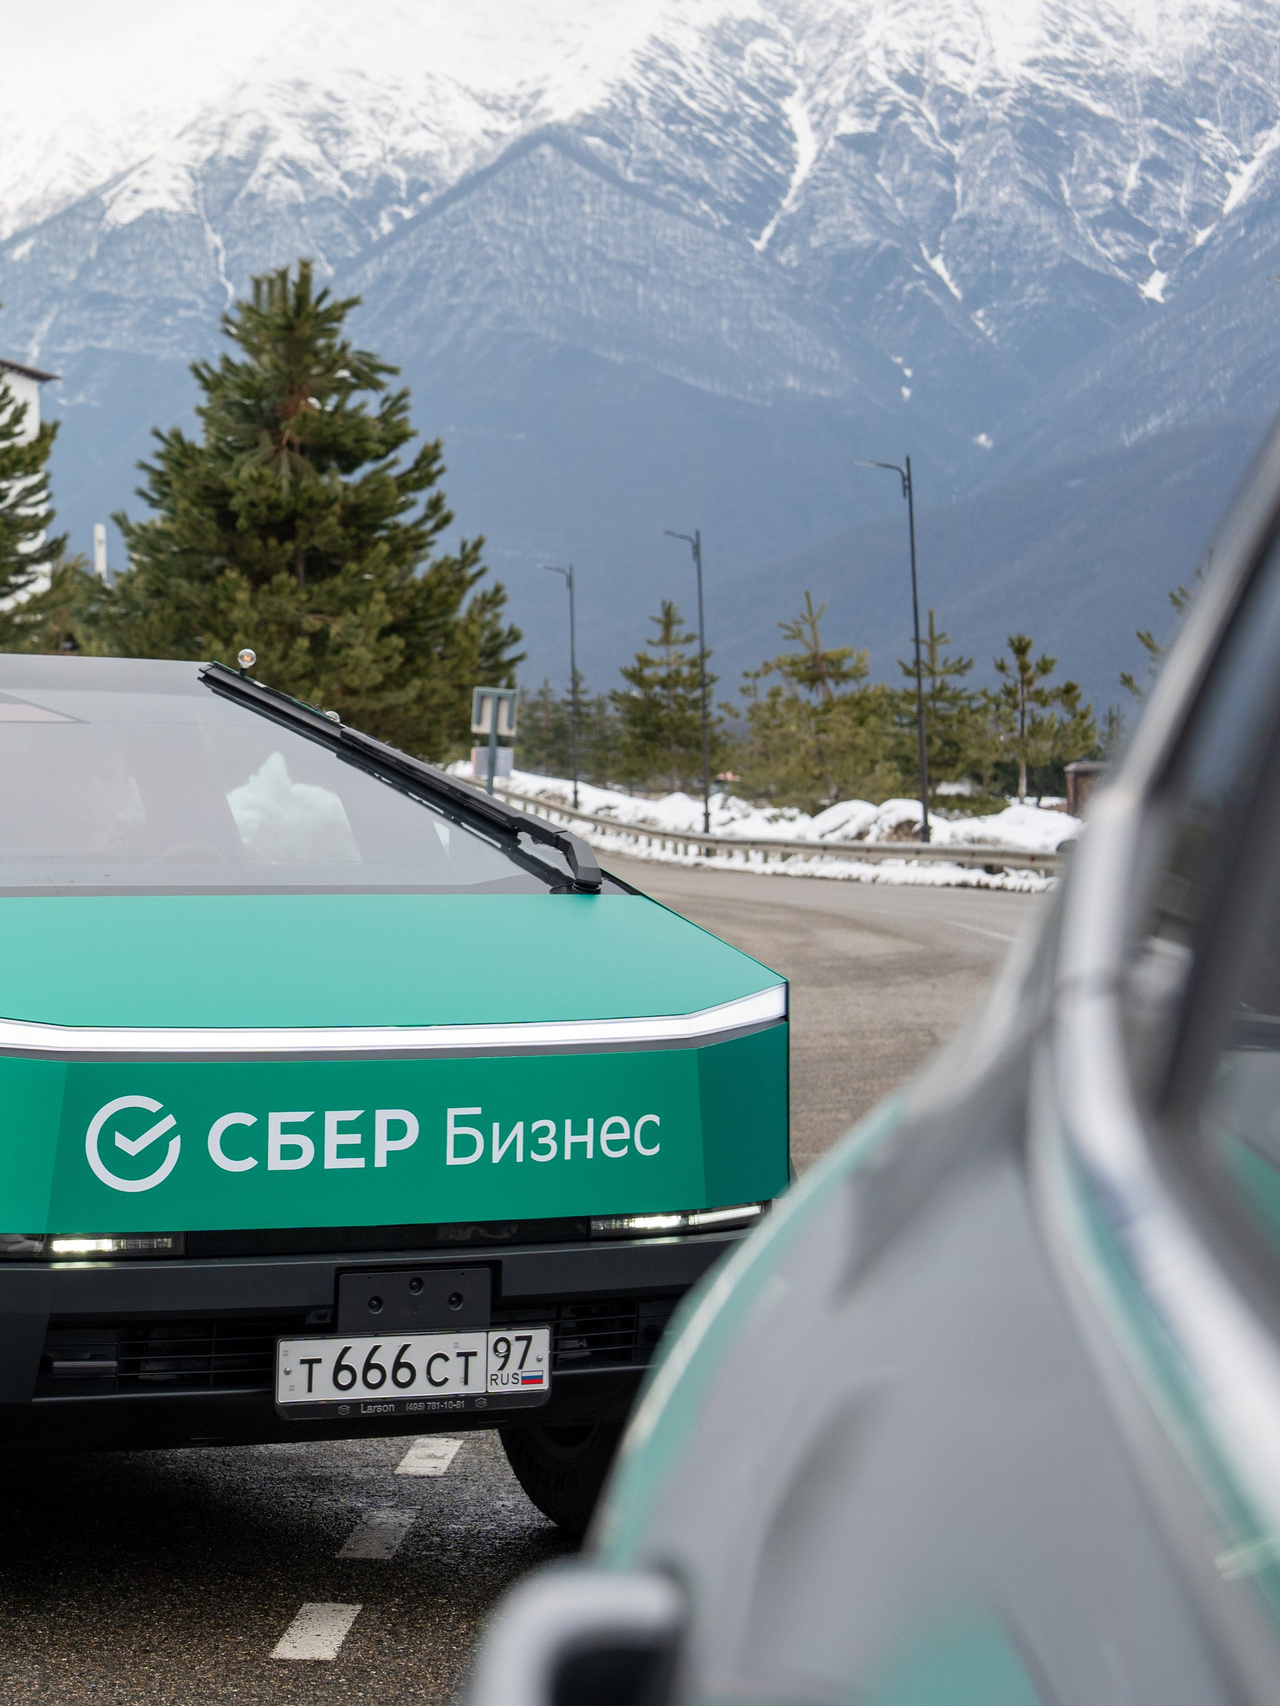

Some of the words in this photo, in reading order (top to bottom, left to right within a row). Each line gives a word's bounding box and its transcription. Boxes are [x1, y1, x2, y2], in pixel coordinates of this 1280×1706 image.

[207, 1109, 420, 1172] СБЕР
[446, 1106, 661, 1166] Бизнес
[492, 1335, 533, 1371] 97
[490, 1373, 520, 1386] RUS
[360, 1403, 395, 1414] Larson
[405, 1401, 425, 1412] (495)
